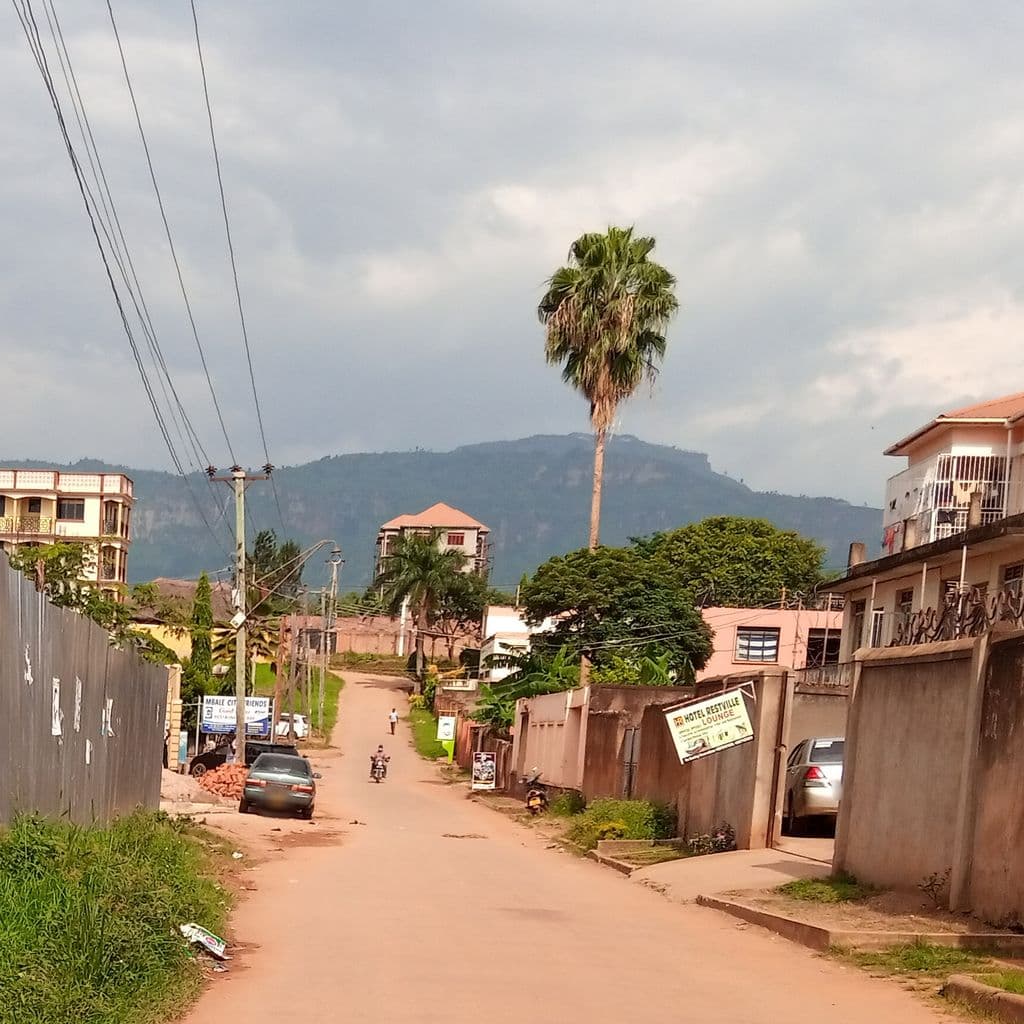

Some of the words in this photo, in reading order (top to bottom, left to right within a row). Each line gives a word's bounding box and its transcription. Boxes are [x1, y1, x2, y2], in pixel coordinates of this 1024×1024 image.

[206, 698, 225, 706] MBALE
[246, 700, 267, 708] RIENDS
[684, 709, 706, 723] HOTEL
[705, 697, 740, 715] RESTVILLE
[702, 709, 735, 726] LOUNGE
